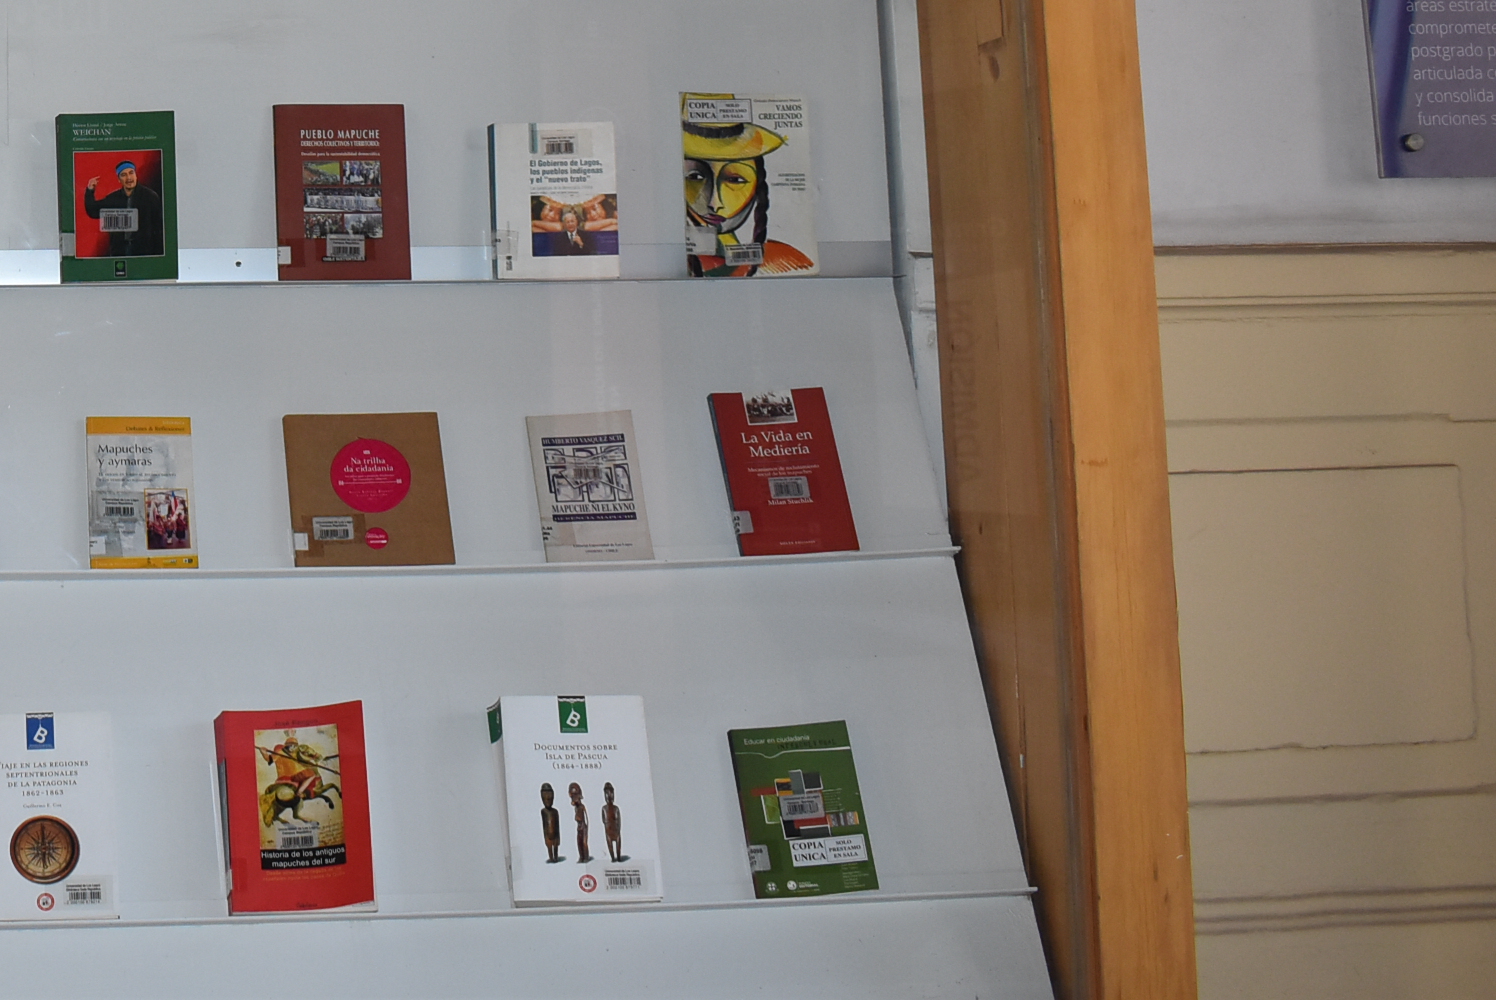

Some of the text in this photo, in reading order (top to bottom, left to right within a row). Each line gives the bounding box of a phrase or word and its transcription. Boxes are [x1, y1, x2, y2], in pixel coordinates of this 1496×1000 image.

[776, 104, 802, 112] VAMOS
[774, 121, 803, 130] JUNTAS
[300, 129, 380, 139] PUEBLO MAPUCHE
[542, 168, 568, 177] pueblos
[741, 430, 813, 444] La Vida en
[98, 444, 153, 457] Mapuches
[749, 444, 810, 458] Mediería
[98, 457, 152, 468] y aymaras
[355, 464, 394, 472] cidadania
[743, 737, 765, 745] Educar
[22, 789, 64, 797] 1862-1863
[792, 842, 824, 850] COPIA
[261, 851, 289, 859] Historia
[315, 846, 345, 857] antiguos
[794, 852, 826, 862] UNICA
[272, 860, 310, 868] mapuches
